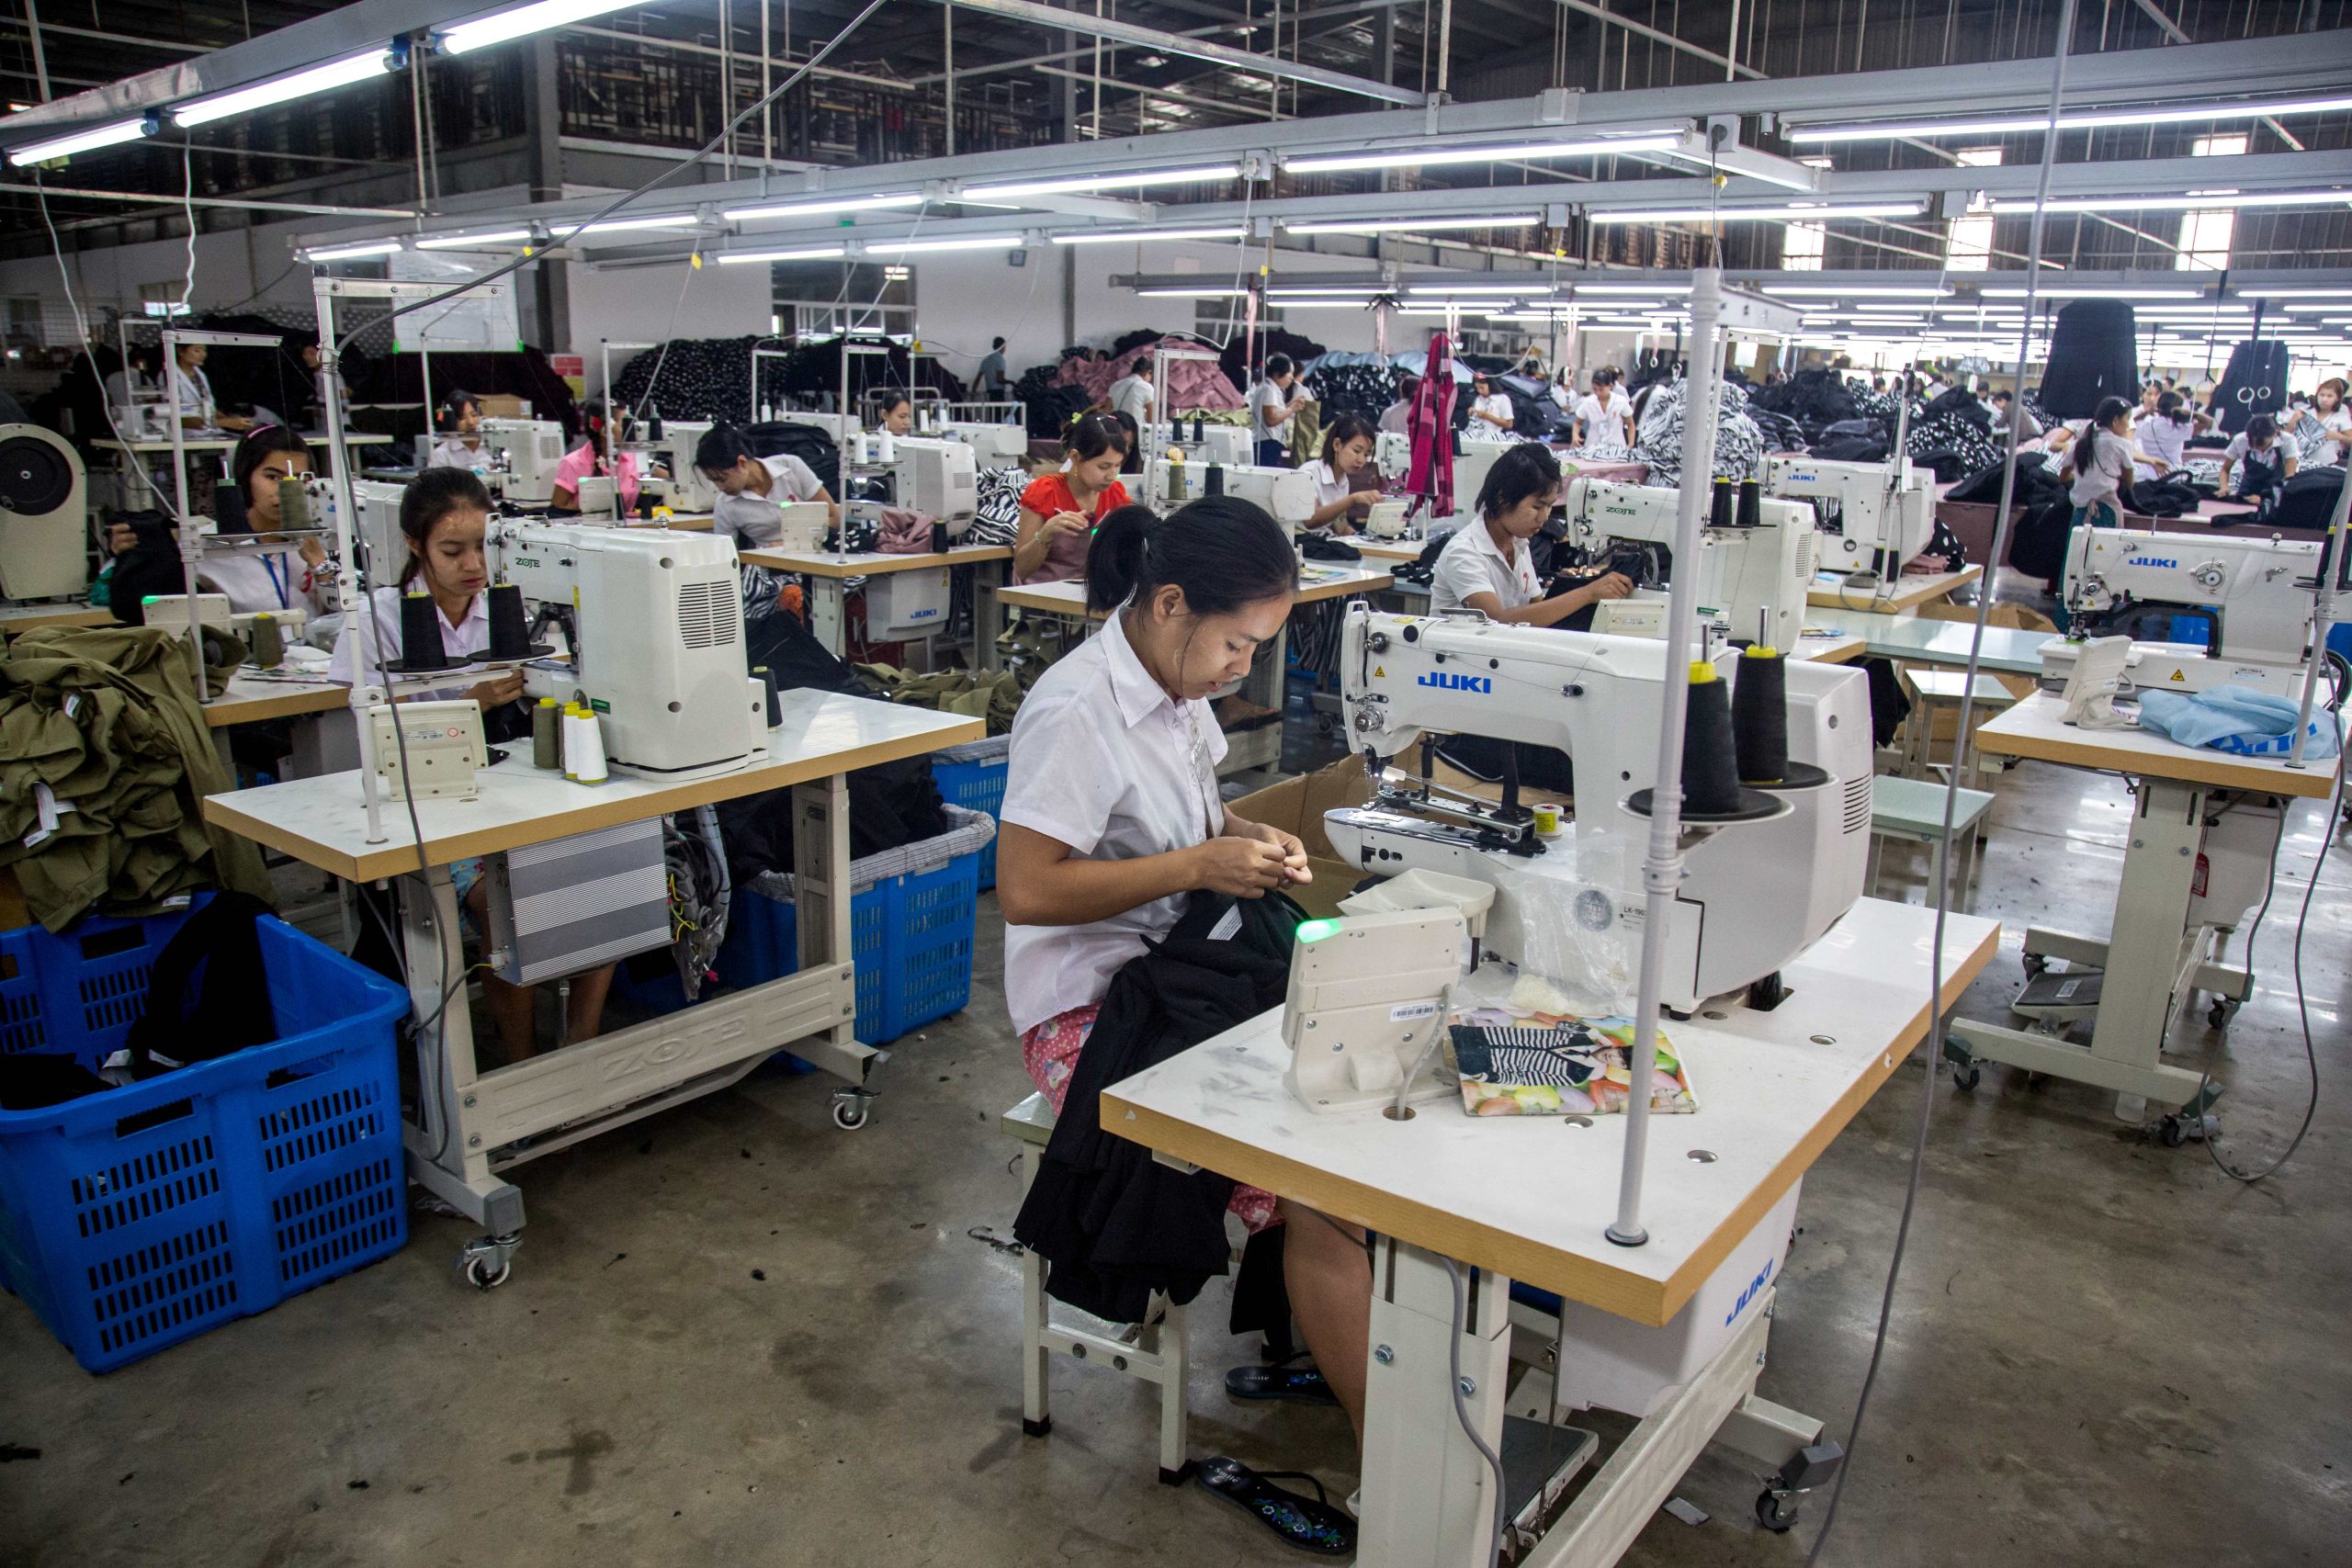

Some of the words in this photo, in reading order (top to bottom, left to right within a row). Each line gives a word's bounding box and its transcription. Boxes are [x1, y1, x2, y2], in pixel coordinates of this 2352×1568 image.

[1606, 507, 1636, 515] ZOJE
[515, 557, 540, 569] ZOJE
[2129, 557, 2177, 569] JUKI
[910, 608, 937, 619] JUKI
[1418, 671, 1492, 694] JUKI
[1623, 906, 1647, 918] LK-190
[602, 1015, 747, 1084] ZOJE
[1725, 1257, 1773, 1328] JUKI
